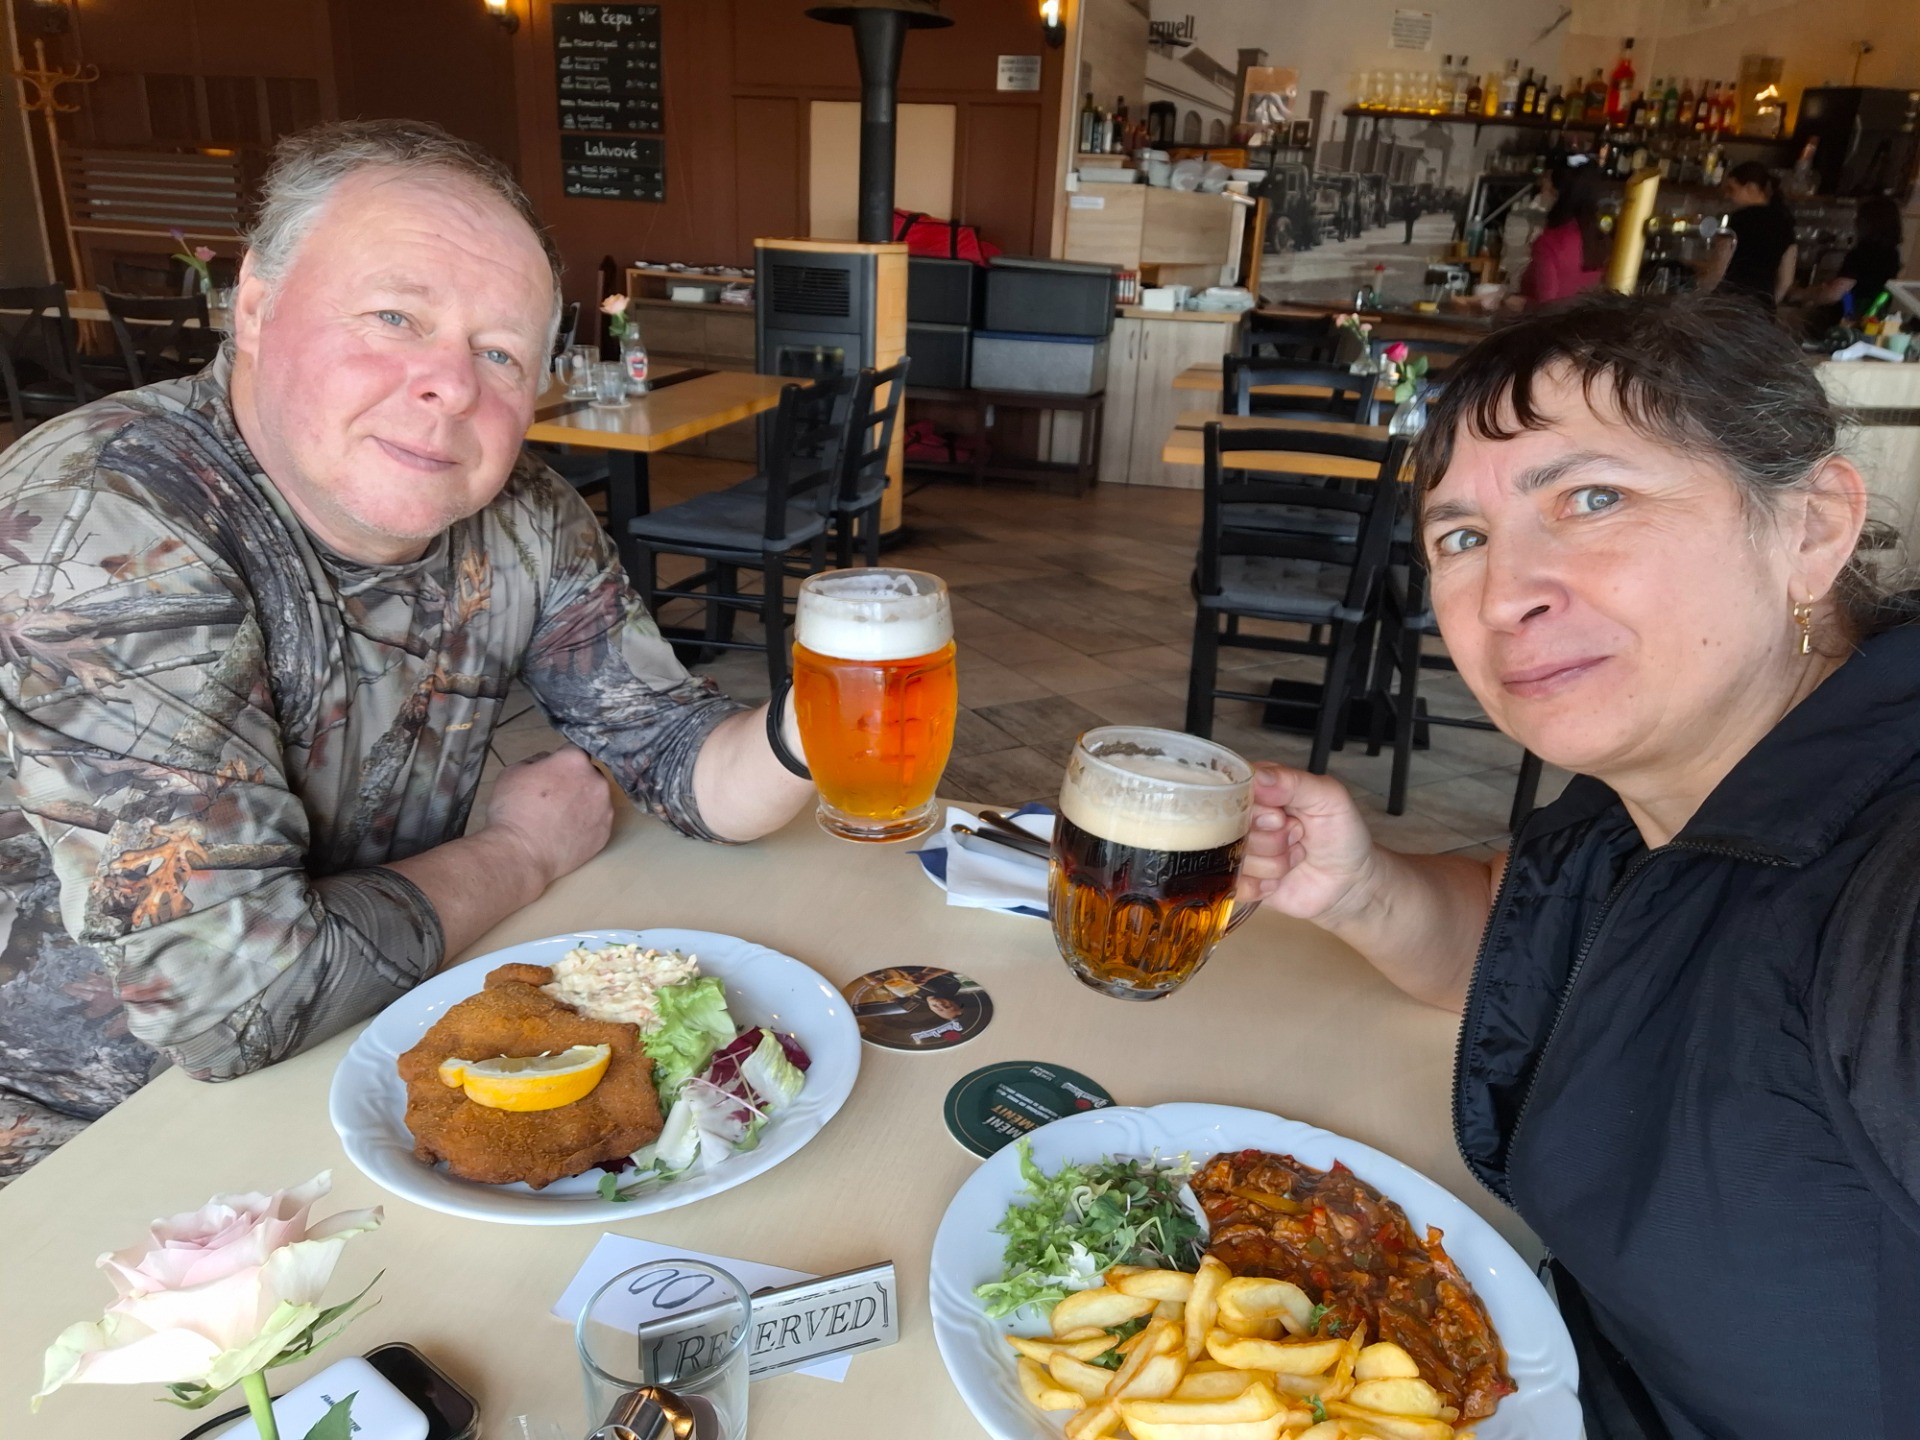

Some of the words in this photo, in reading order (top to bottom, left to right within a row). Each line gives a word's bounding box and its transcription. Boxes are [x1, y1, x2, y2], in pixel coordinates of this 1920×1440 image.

[578, 9, 597, 25] Na
[601, 7, 633, 32] čepu
[1149, 14, 1195, 48] rquell
[584, 140, 638, 160] Lahvové
[981, 1115, 1024, 1138] MĚNÍ
[991, 1104, 1040, 1131] MĚNIT
[670, 1296, 877, 1384] RESERVED
